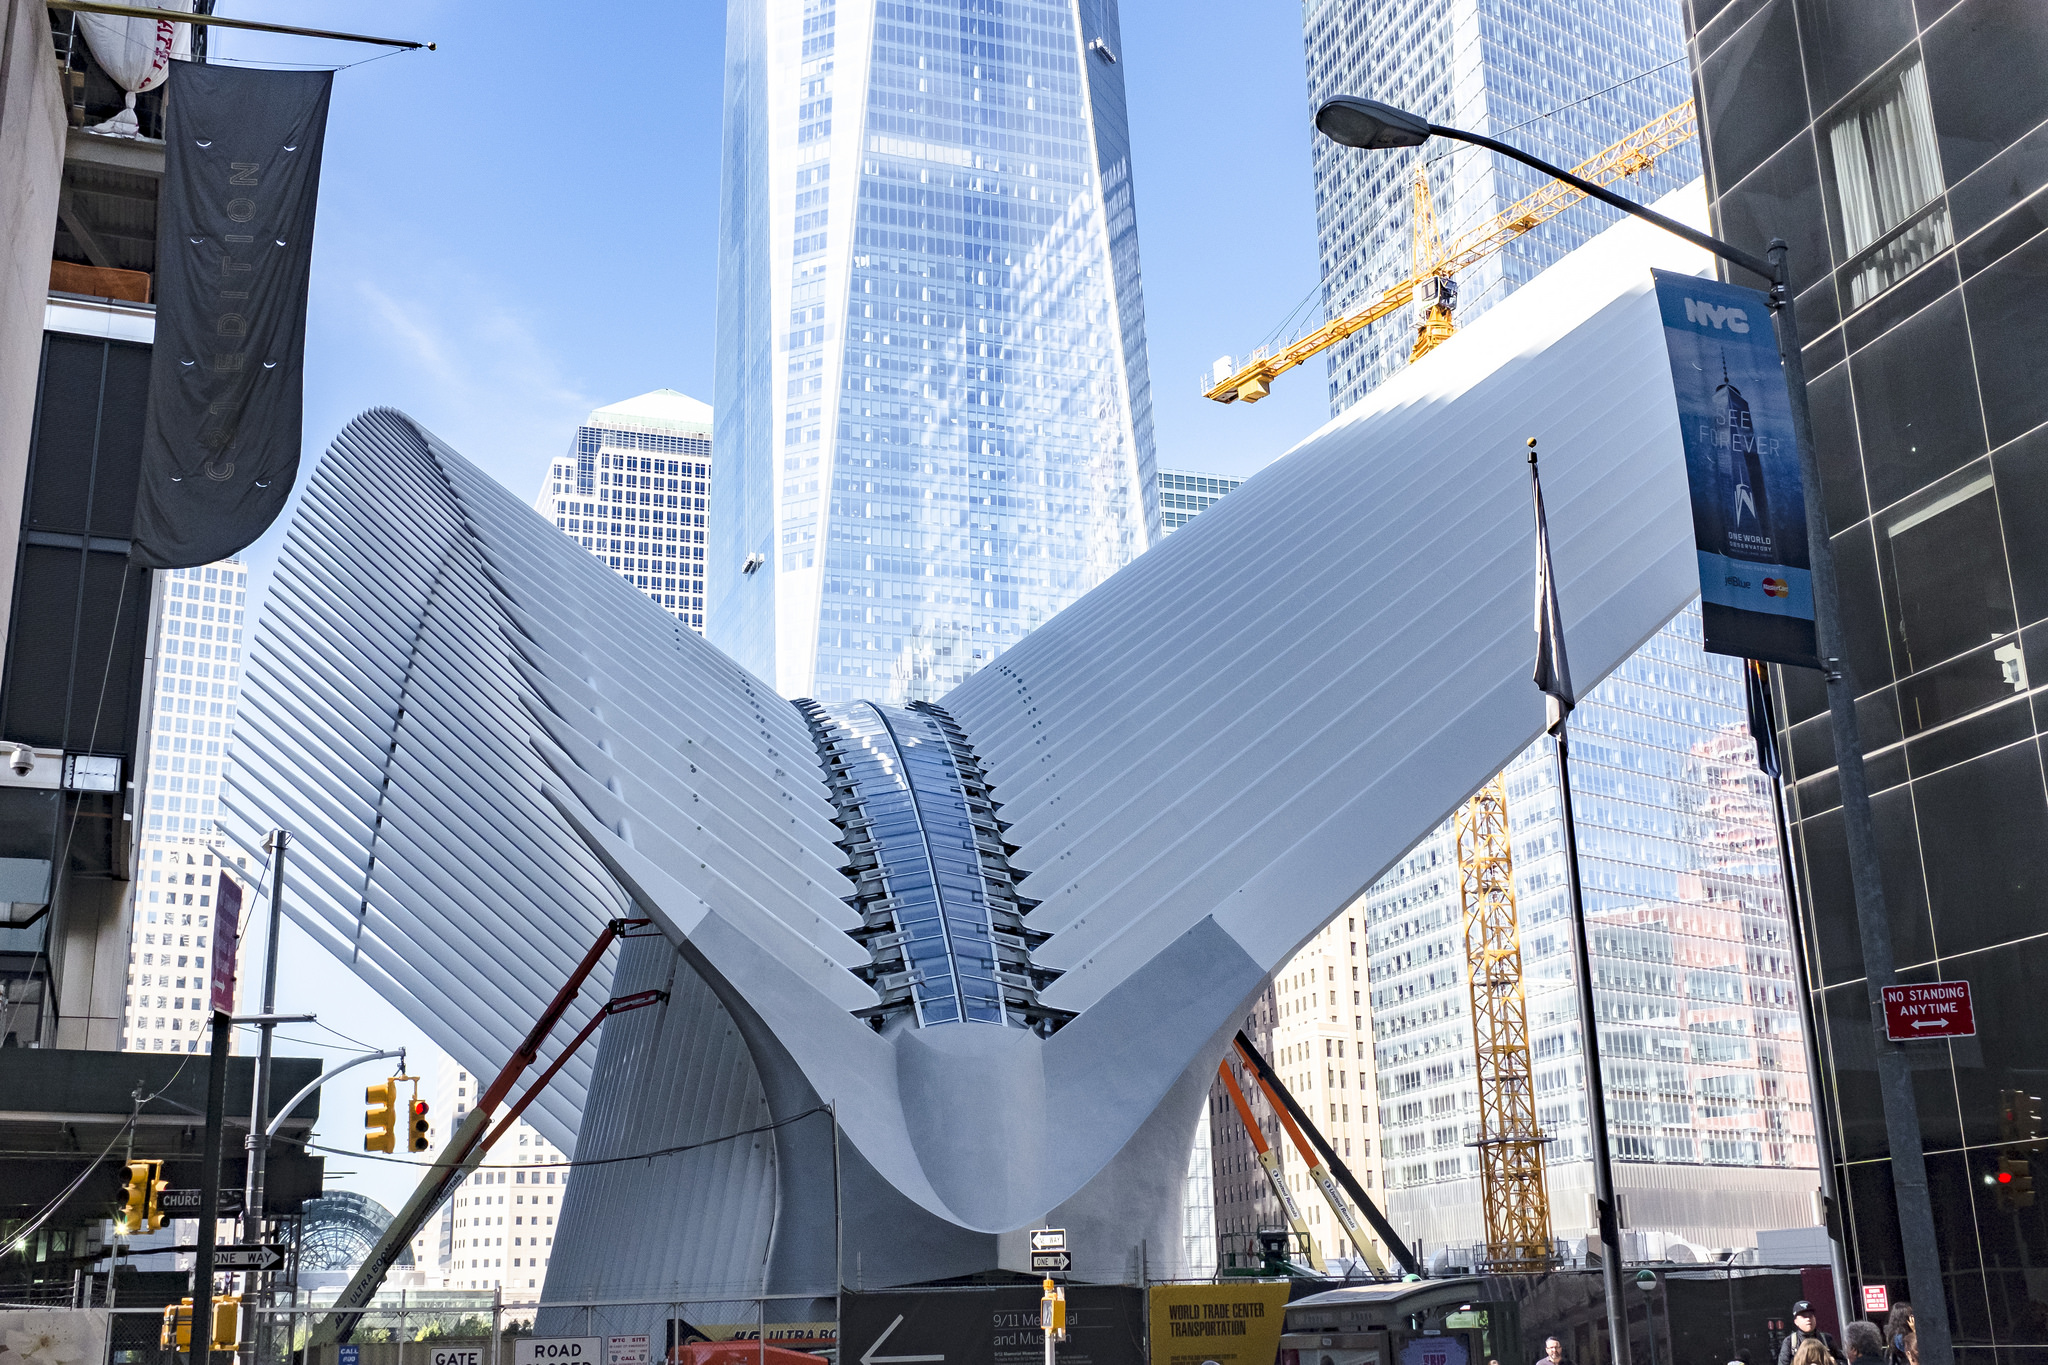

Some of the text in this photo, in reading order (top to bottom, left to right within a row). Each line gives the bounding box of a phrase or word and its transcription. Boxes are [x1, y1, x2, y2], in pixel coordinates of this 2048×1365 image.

[214, 162, 259, 372] EDITION
[1684, 297, 1750, 334] NYC
[1716, 408, 1750, 429] SEE
[1699, 425, 1780, 457] FOREVER
[1729, 541, 1772, 552] OBSERVATORY
[1743, 534, 1771, 545] WORLD
[1888, 986, 1965, 1003] NO STANDING
[1900, 1002, 1958, 1016] ANYTIME
[1277, 1176, 1298, 1218] United Rentals
[1329, 1187, 1355, 1229] United Rentals
[247, 1253, 272, 1263] WAY
[1036, 1257, 1066, 1266] ONE WAY
[350, 1273, 374, 1304] ULTRA
[1169, 1302, 1265, 1320] WORLD TRADE CENTER
[993, 1313, 1019, 1328] 9/11
[1169, 1320, 1246, 1337] TRANSPORTATION
[993, 1332, 1016, 1346] and
[435, 1352, 478, 1365] GATE
[534, 1344, 582, 1358] ROAD
